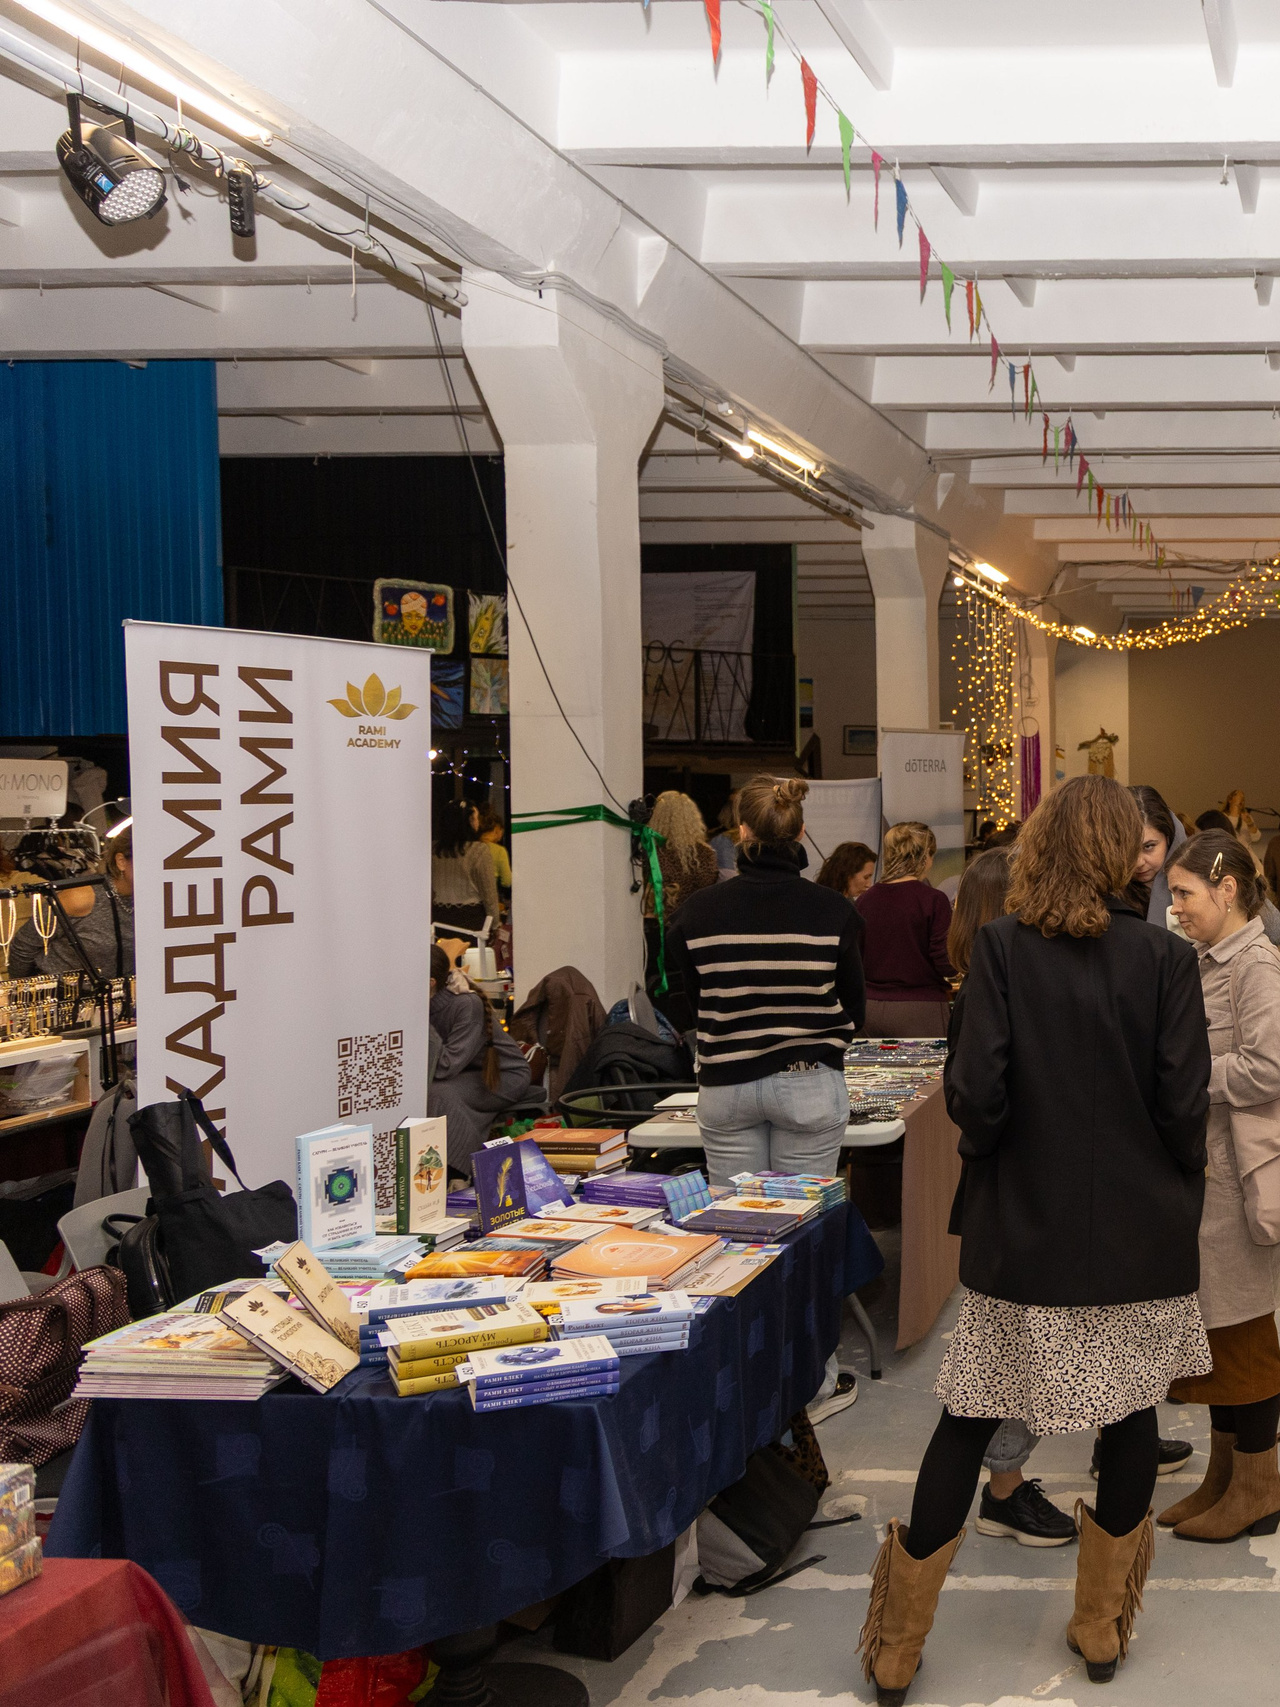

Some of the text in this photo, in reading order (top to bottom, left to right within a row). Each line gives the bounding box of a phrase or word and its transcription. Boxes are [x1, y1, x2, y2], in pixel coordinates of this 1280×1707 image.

[358, 725, 387, 736] RAMI
[347, 737, 401, 749] ACADEMY
[238, 666, 294, 928] РАМИ
[489, 1206, 526, 1226] ЗОЛОТЫЕ
[625, 1315, 668, 1326] ВТОРАЯ ЖЕНА
[620, 1326, 663, 1336] ВТОРАЯ ЖЕНА
[435, 1332, 497, 1349] МУДРОСТЬ
[643, 1335, 663, 1343] ЖЕНА
[433, 1354, 469, 1367] РОСТЬ
[483, 1373, 524, 1384] РАМИ БЛЕКТ
[483, 1386, 524, 1397] РАМИ БЛЕКТ
[482, 1398, 523, 1409] РАМИ БЛЕКТ
